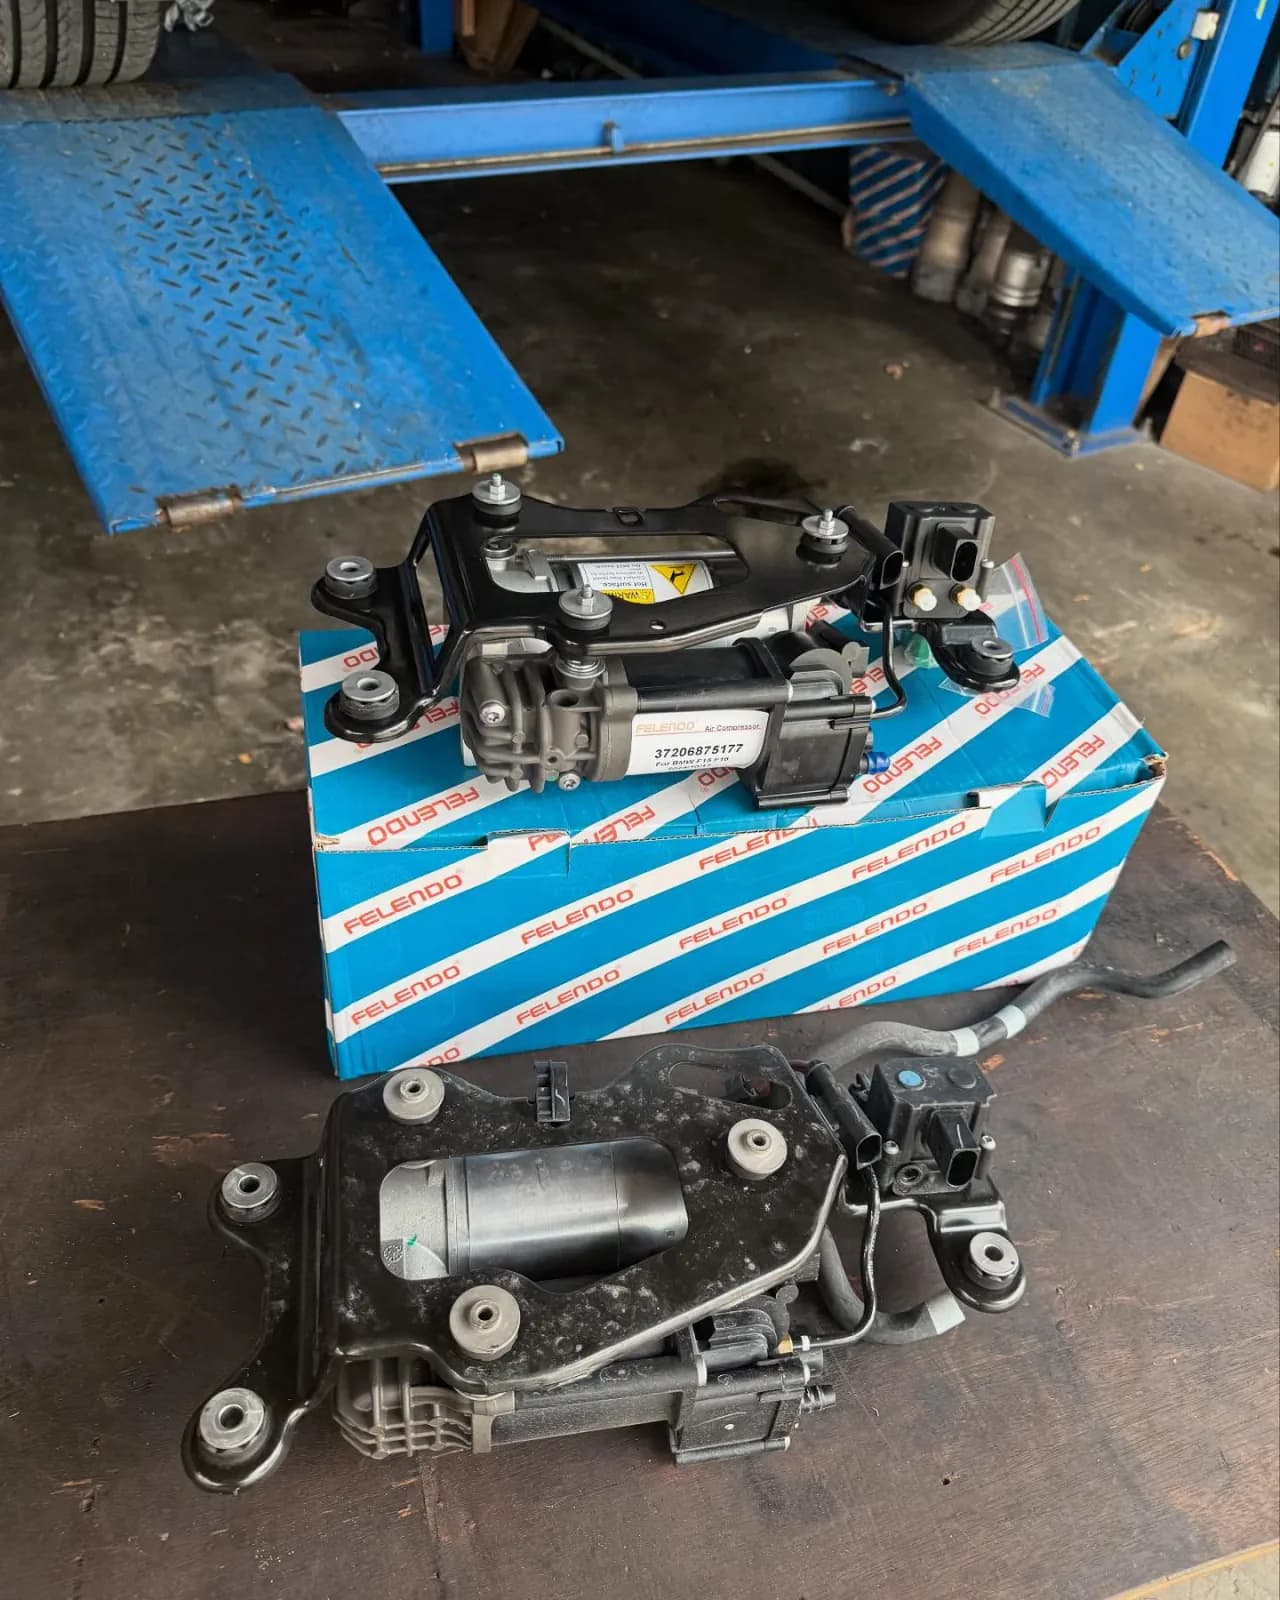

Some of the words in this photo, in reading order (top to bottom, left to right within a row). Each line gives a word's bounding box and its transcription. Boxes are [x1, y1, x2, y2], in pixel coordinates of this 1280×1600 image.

[654, 743, 744, 759] 37206875177
[704, 724, 716, 733] Air
[671, 758, 695, 766] BMW
[863, 736, 942, 793] FELENDO
[1041, 731, 1105, 788] FELEND
[367, 786, 480, 846] FELENDO
[852, 820, 967, 879] FELENDO
[990, 826, 1101, 882] FELENDO
[344, 874, 463, 935] FELENDO
[521, 889, 634, 945] FELENDO
[679, 897, 787, 950] FELENDO
[822, 902, 927, 954] FELENDO
[953, 908, 1057, 958] FELENDO
[351, 965, 460, 1025] FELENDO
[516, 969, 620, 1025] FELENDO
[665, 972, 765, 1025] FELENDO
